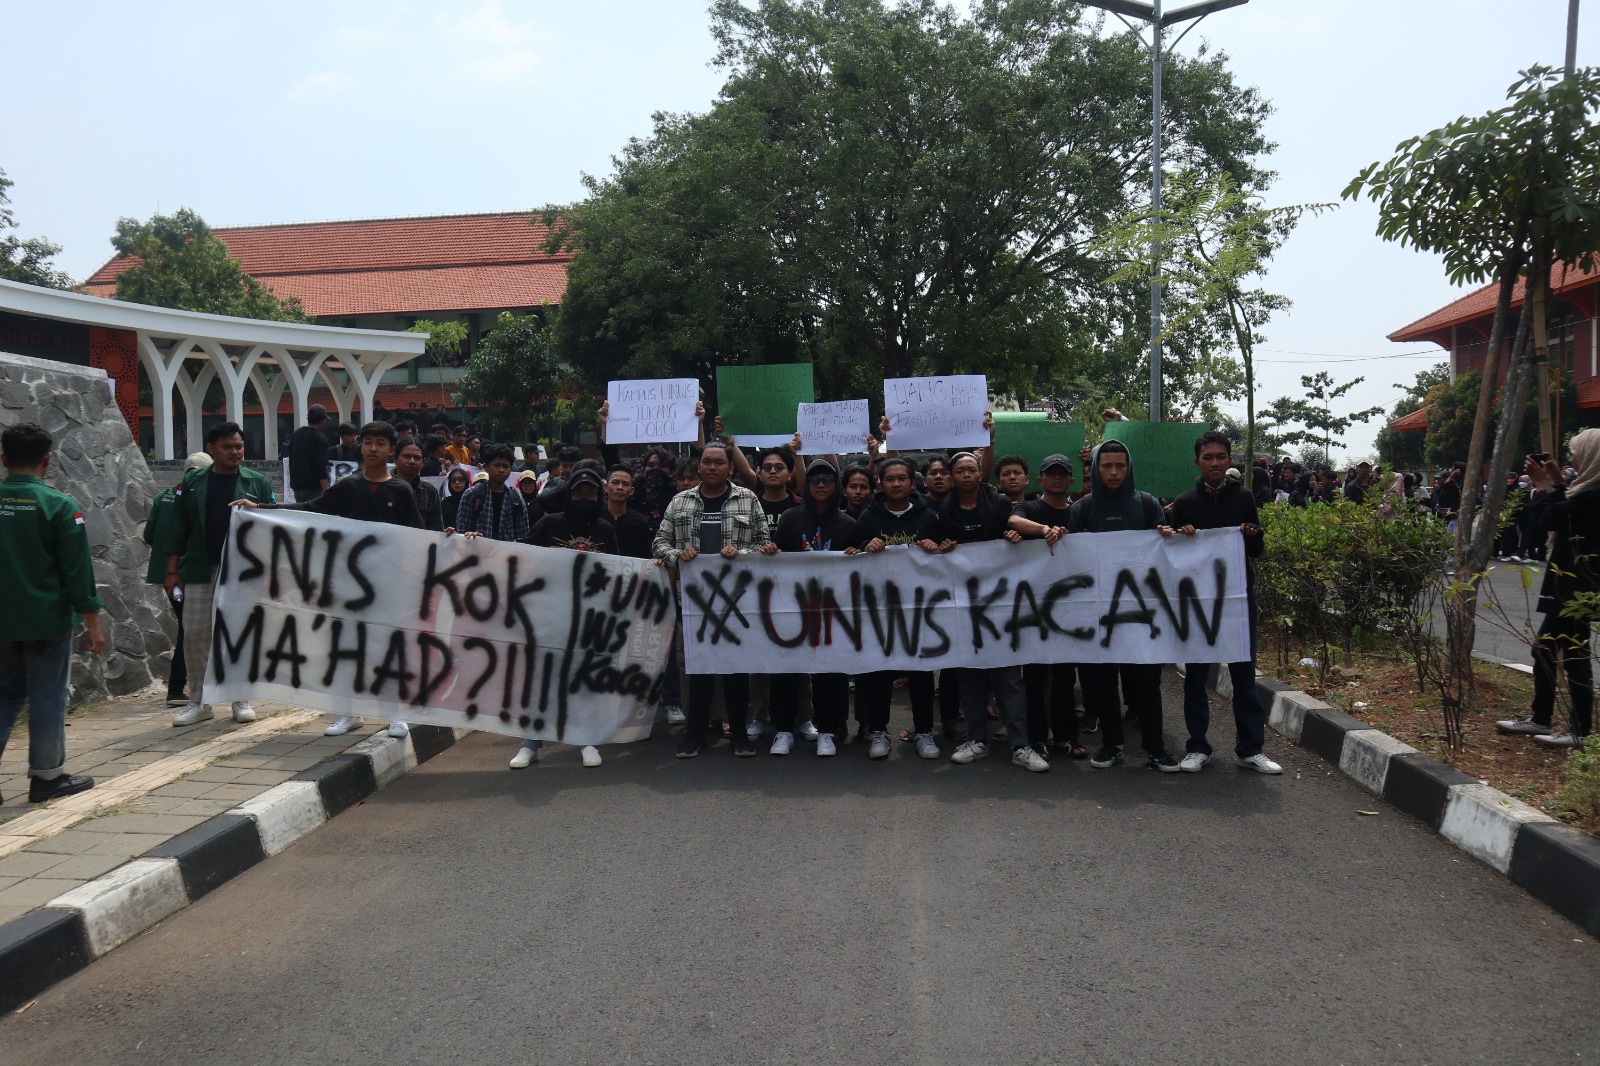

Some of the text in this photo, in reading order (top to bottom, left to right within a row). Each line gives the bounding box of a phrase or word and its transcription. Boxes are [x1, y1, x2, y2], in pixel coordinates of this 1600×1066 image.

[617, 384, 656, 402] KAMPUS
[893, 380, 947, 404] UANG
[631, 403, 677, 421] TUKANG
[628, 420, 680, 439] DOBOL
[580, 607, 631, 654] WS
